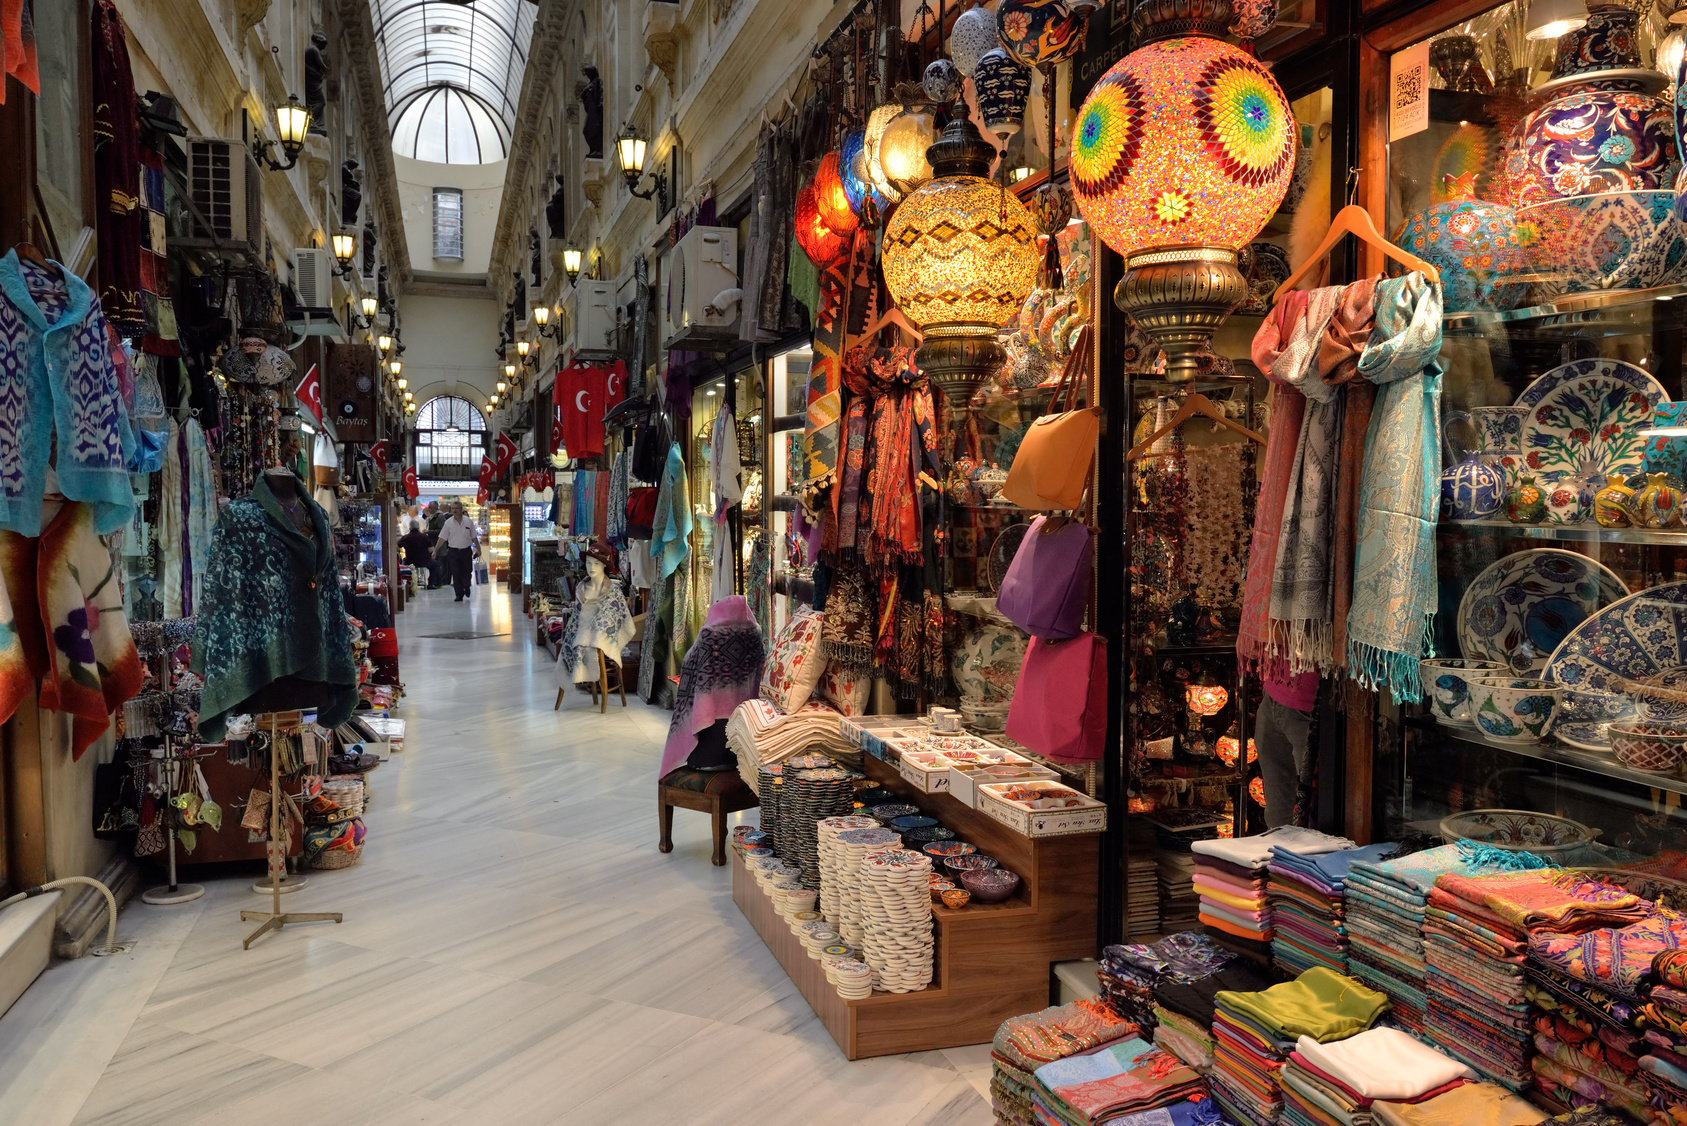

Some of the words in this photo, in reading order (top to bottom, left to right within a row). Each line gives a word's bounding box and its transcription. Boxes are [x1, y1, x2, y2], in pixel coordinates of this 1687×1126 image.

[1080, 40, 1125, 81] CARPET
[1128, 31, 1138, 50] &
[336, 415, 368, 428] Baytaş
[1057, 821, 1070, 830] Set
[1072, 820, 1086, 828] Tea
[1088, 818, 1101, 826] Lux
